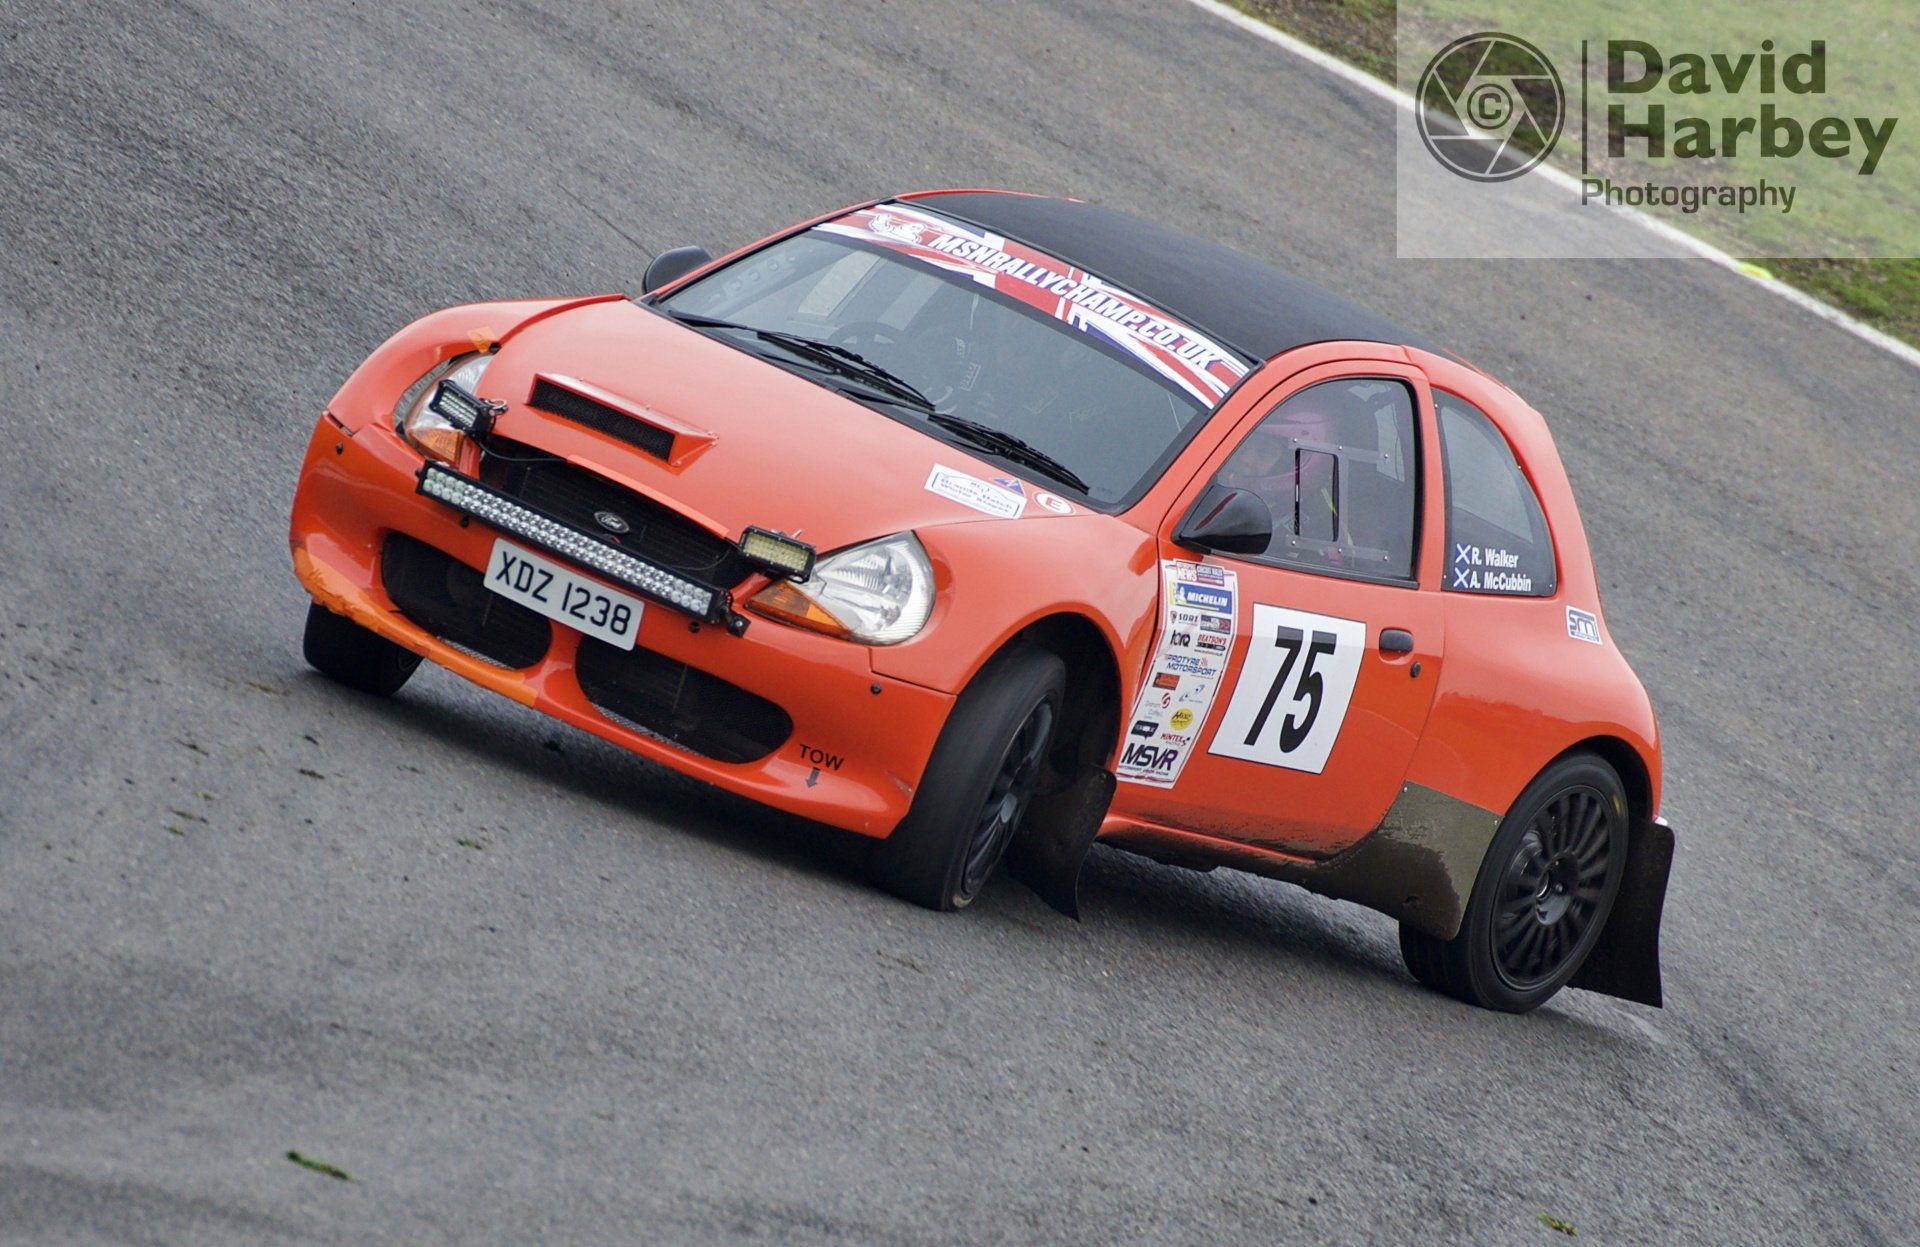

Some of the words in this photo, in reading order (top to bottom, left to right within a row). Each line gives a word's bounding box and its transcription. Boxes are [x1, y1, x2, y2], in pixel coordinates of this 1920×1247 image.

[928, 235, 1221, 370] MSNRALLYCHAMP.CO.UK
[1471, 547, 1482, 565] R.
[1485, 548, 1519, 568] Walker
[496, 551, 553, 603] XDZ
[561, 582, 632, 635] 1238
[1469, 571, 1481, 589] A.
[1483, 571, 1532, 592] McCubbin
[1187, 592, 1227, 606] MICHELIN
[1166, 662, 1217, 676] MOTORSPORT
[1167, 654, 1200, 665] PROTYRE
[1243, 625, 1337, 753] 75
[800, 744, 844, 770] TOW
[1121, 742, 1179, 771] MSVR
